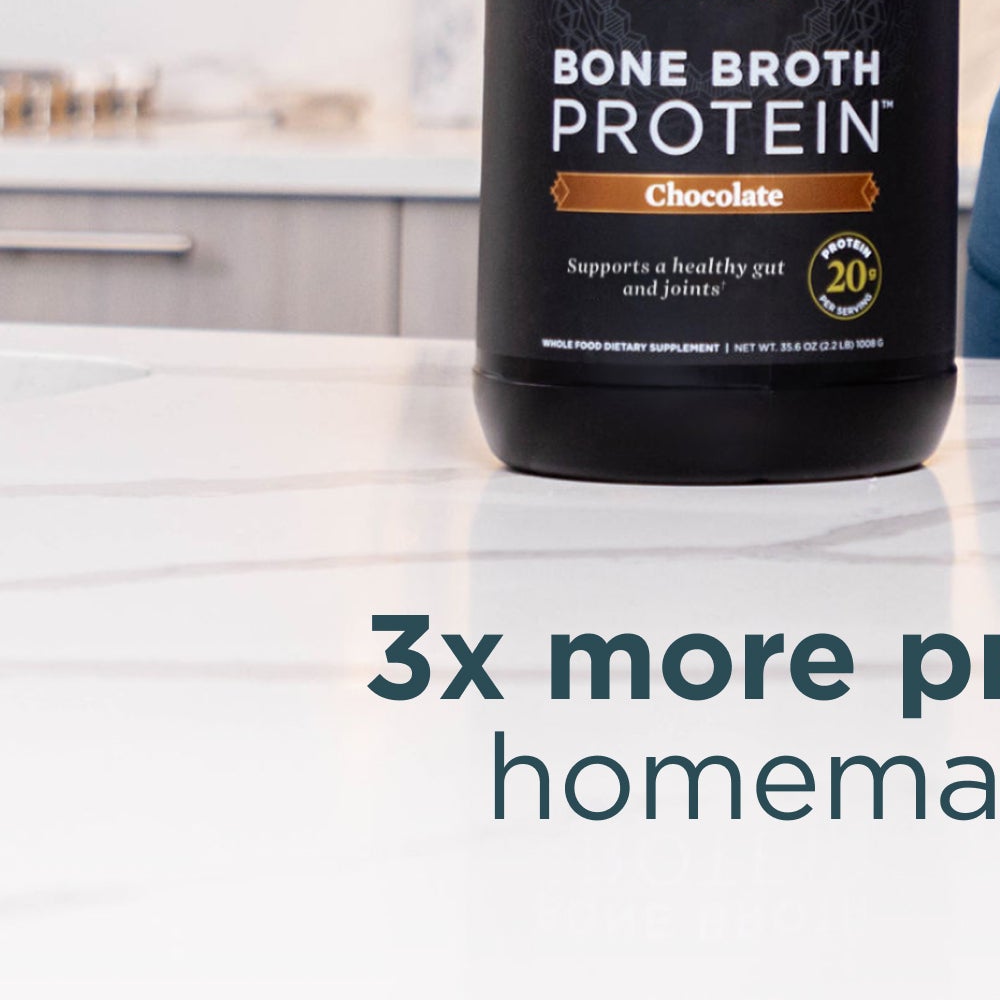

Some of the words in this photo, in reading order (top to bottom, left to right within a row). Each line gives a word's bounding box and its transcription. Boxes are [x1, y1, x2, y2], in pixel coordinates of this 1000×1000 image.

[554, 49, 687, 86] BONE
[711, 50, 879, 87] BROTH
[645, 181, 783, 207] Chocolate
[821, 237, 872, 260] PROTEIN
[567, 257, 650, 278] Supports
[655, 262, 666, 274] a
[672, 256, 748, 279] healthy
[751, 260, 785, 279] gut
[622, 279, 658, 296] and
[541, 338, 574, 350] WHOLE
[573, 339, 603, 352] FOOD
[602, 341, 648, 353] DIETARY
[648, 342, 721, 354] SUPPLEMENT
[733, 342, 756, 353] NET
[757, 342, 777, 353] WT.
[780, 342, 802, 353] 35.6
[802, 341, 818, 352] OZ
[876, 338, 884, 348] G
